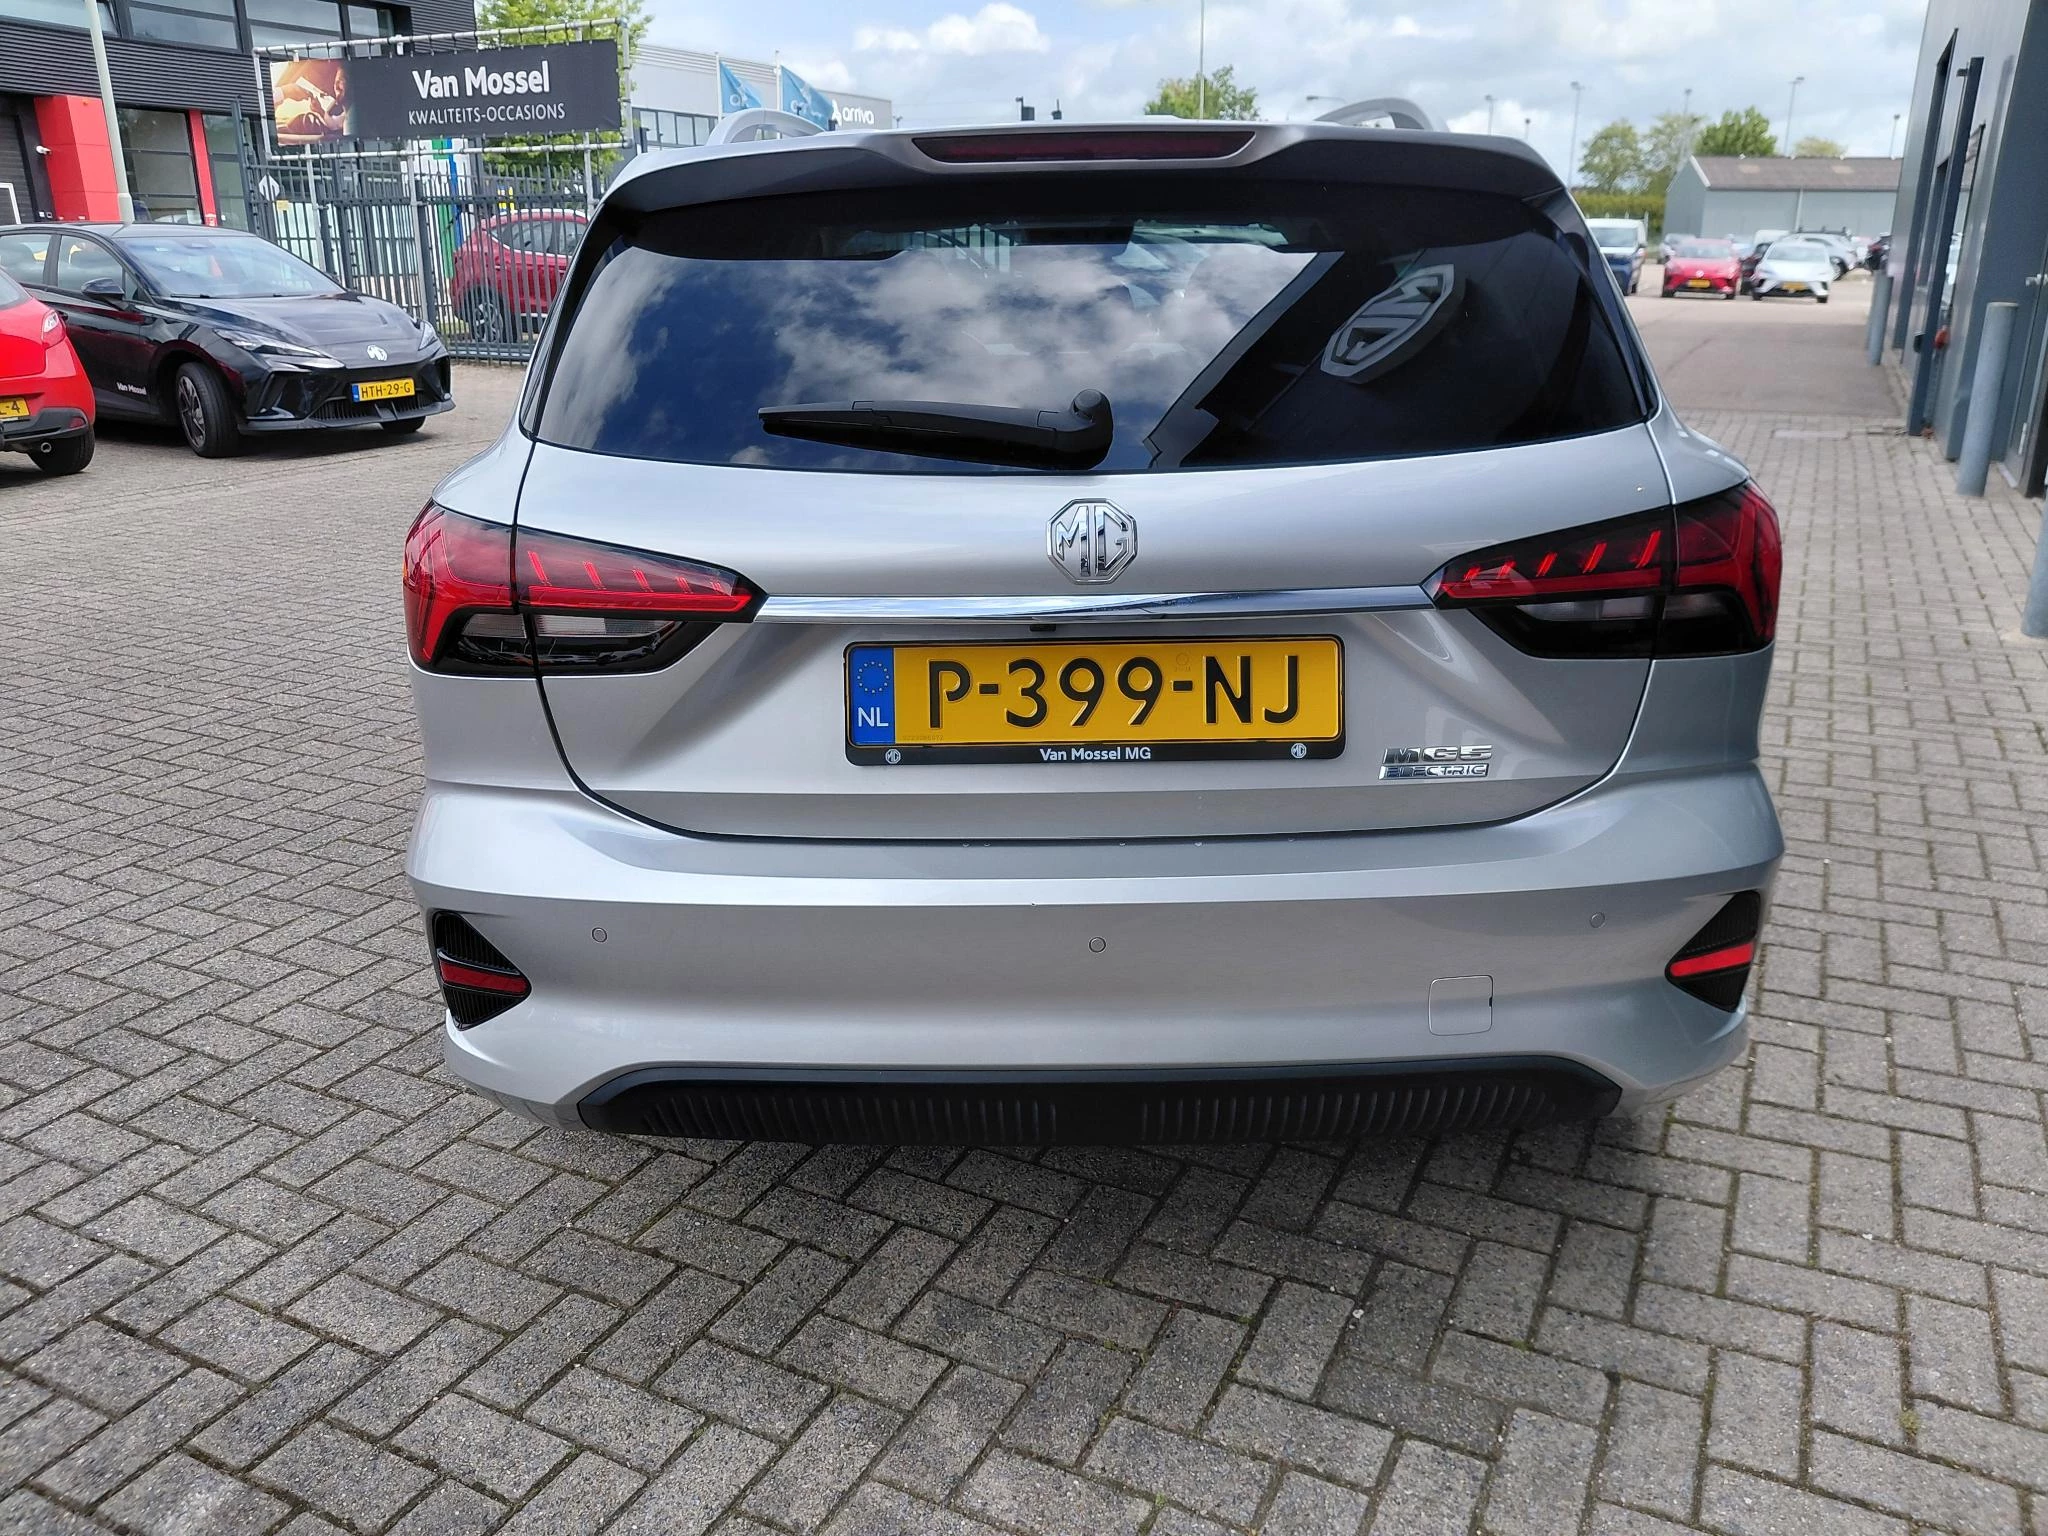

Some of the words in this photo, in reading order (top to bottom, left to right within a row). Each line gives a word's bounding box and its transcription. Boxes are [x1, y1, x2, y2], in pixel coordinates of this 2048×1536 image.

[412, 68, 459, 99] Van
[464, 60, 550, 97] Mossel
[408, 102, 566, 126] KWALITEITS-OCCASIONS
[842, 106, 875, 125] arriva
[116, 381, 128, 392] Van
[361, 382, 411, 399] HTH-29-G
[1052, 503, 1131, 578] MG
[928, 655, 1299, 729] P-399-NJ
[857, 706, 889, 727] NL
[885, 748, 901, 764] MG
[1040, 748, 1067, 761] Van
[1071, 746, 1121, 761] Mossel
[1125, 746, 1152, 760] MG
[1290, 743, 1307, 759] MG
[1383, 745, 1492, 763] MG5
[1382, 763, 1488, 779] ELECTRIC
